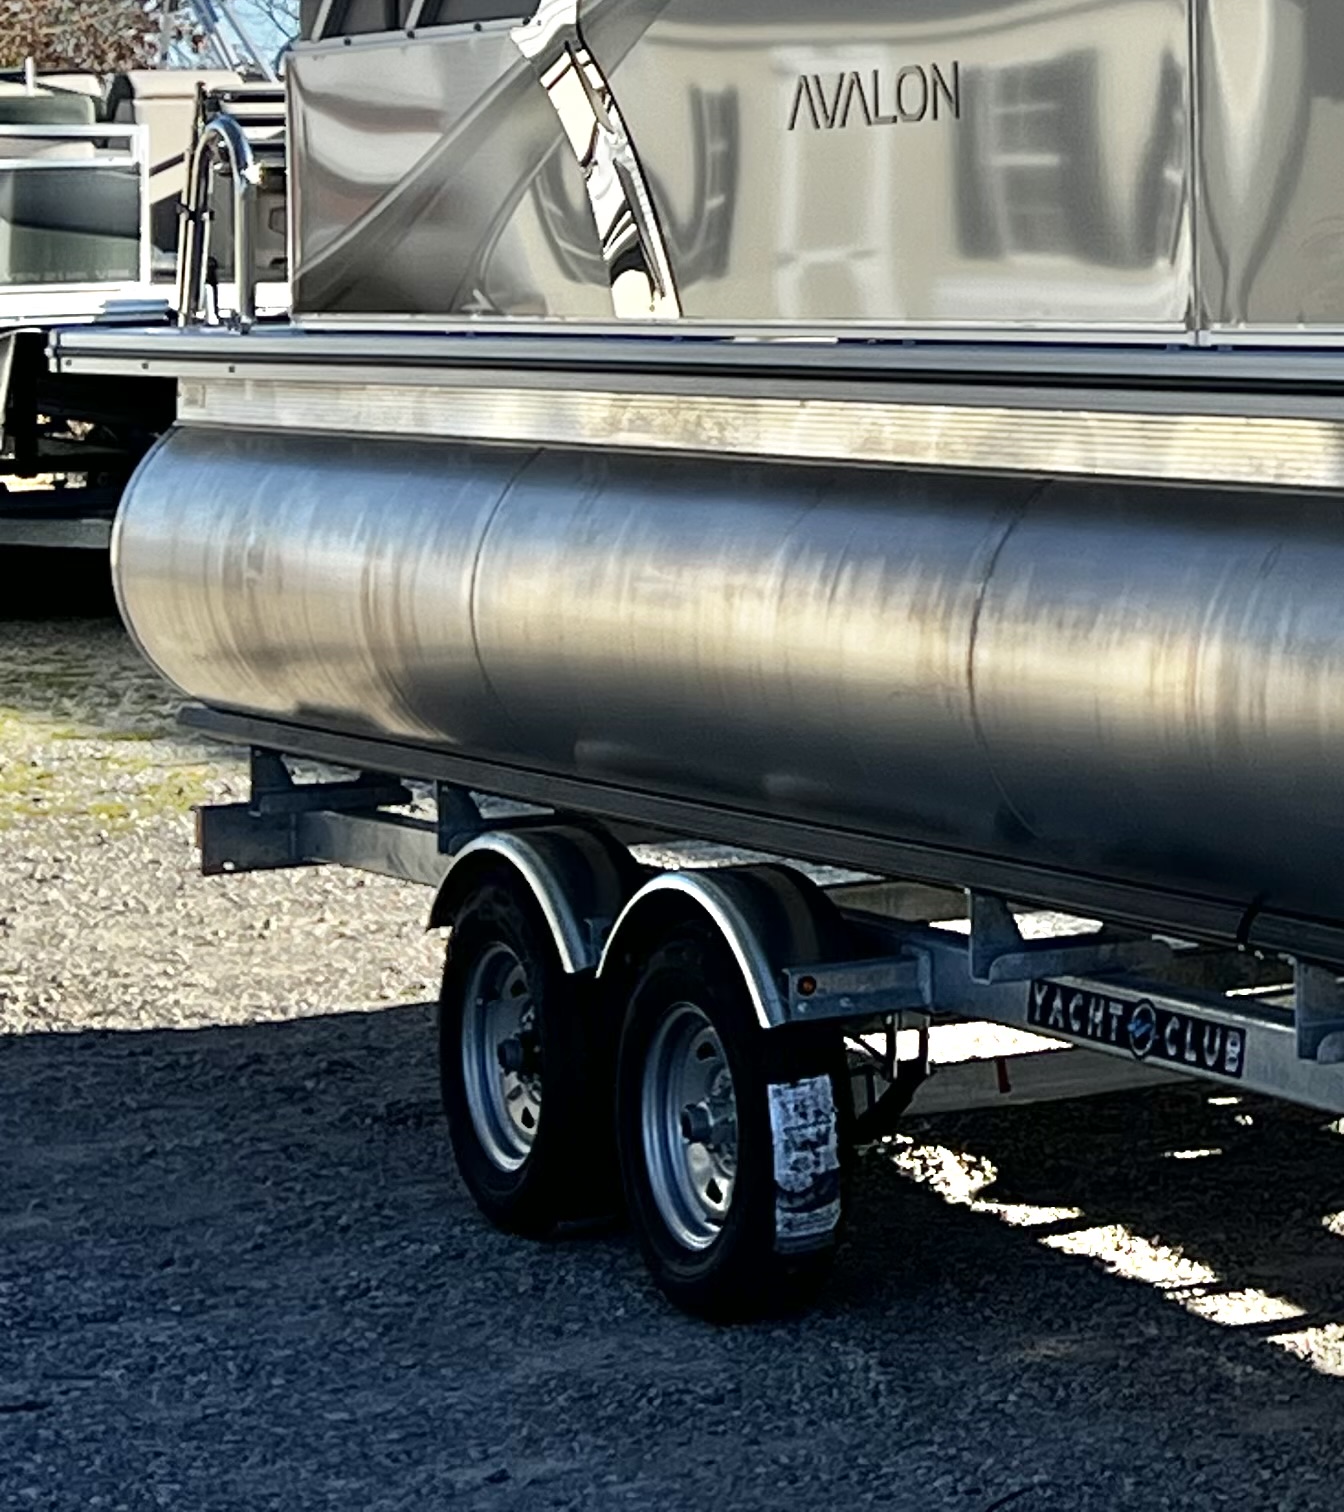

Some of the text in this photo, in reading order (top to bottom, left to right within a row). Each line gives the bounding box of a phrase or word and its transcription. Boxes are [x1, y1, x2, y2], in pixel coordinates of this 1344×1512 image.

[786, 61, 961, 131] AVALON
[1033, 983, 1242, 1073] YACHT CLUB
